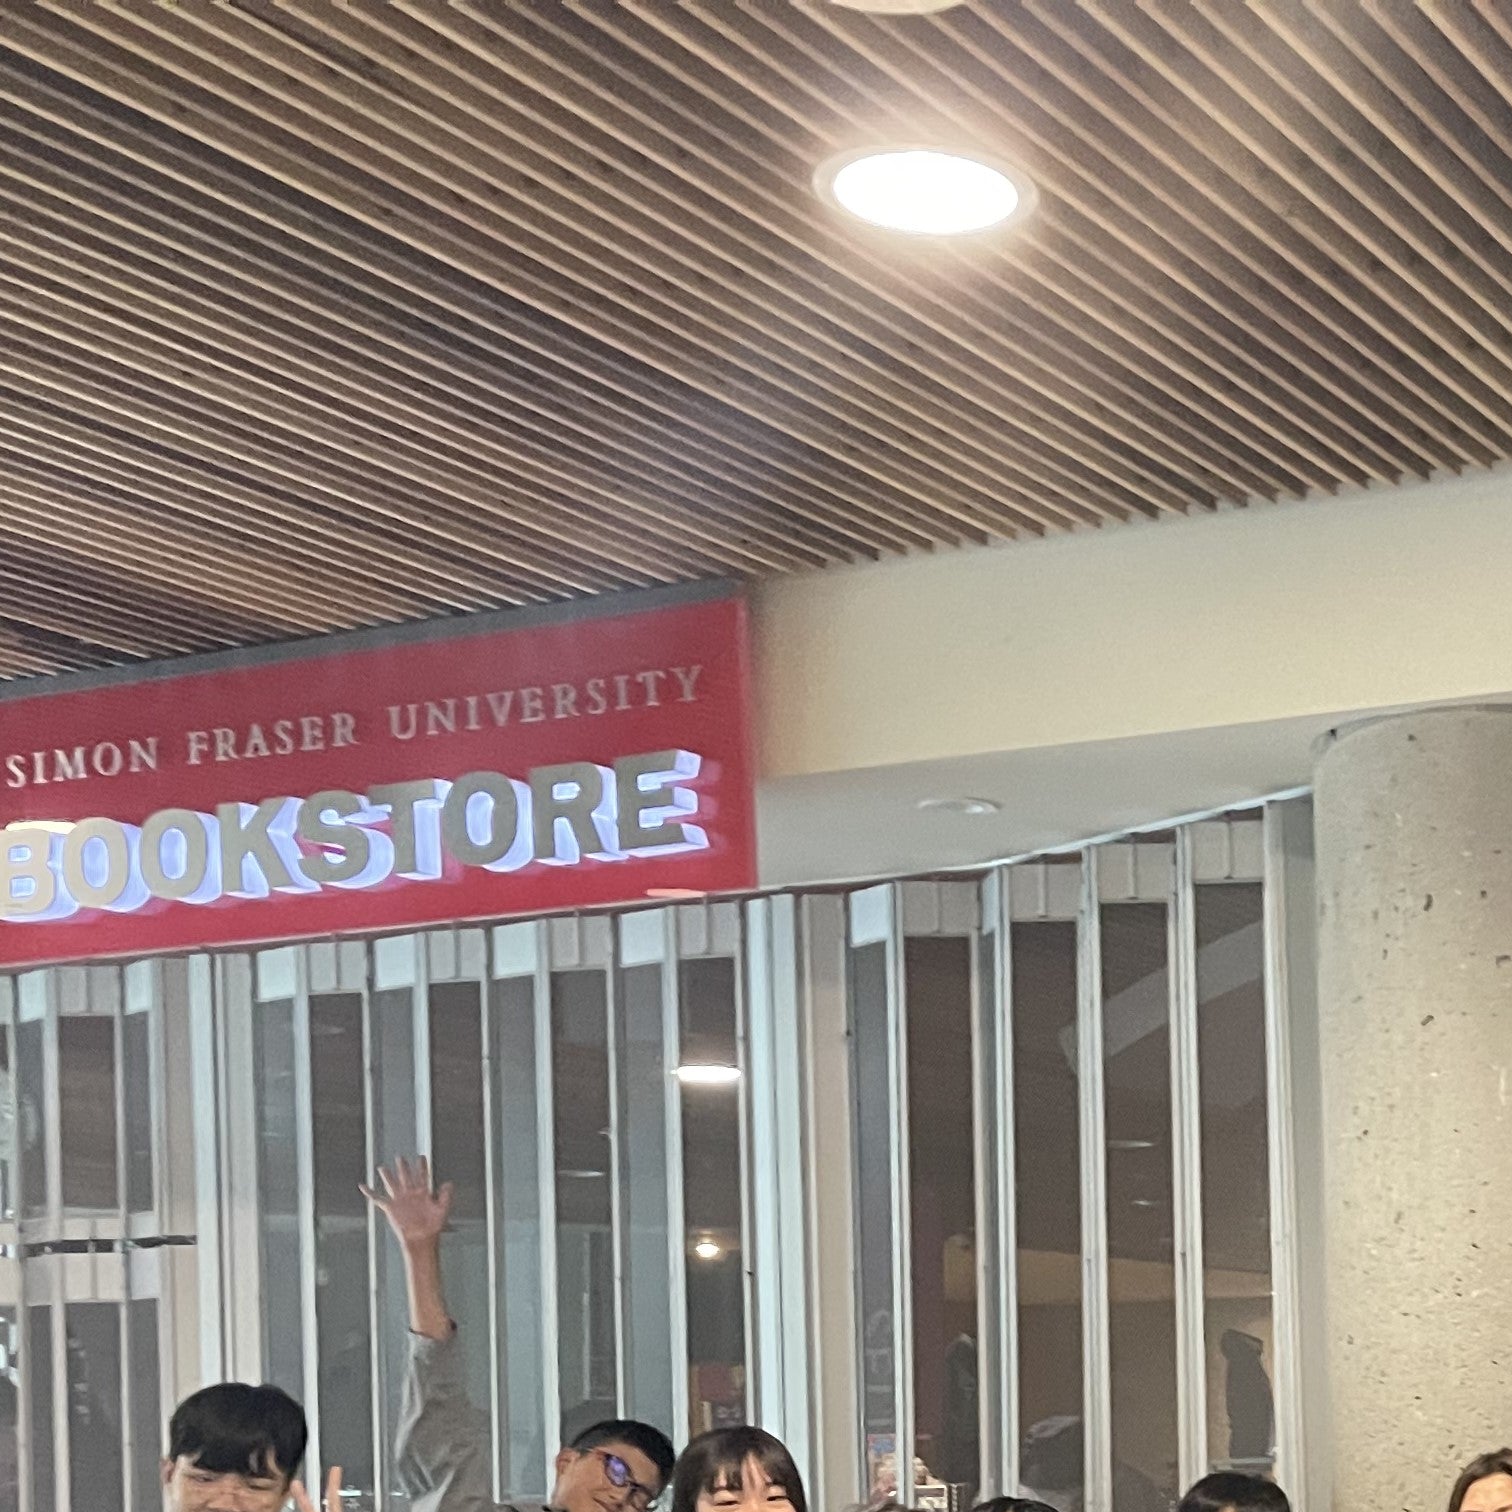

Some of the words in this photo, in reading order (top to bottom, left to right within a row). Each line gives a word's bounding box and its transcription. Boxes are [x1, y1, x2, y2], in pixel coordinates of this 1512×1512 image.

[5, 737, 159, 788] SIMON
[186, 712, 360, 765] FRASER
[386, 664, 704, 740] UNIVERSITY
[0, 748, 709, 922] BOOKSTORE
